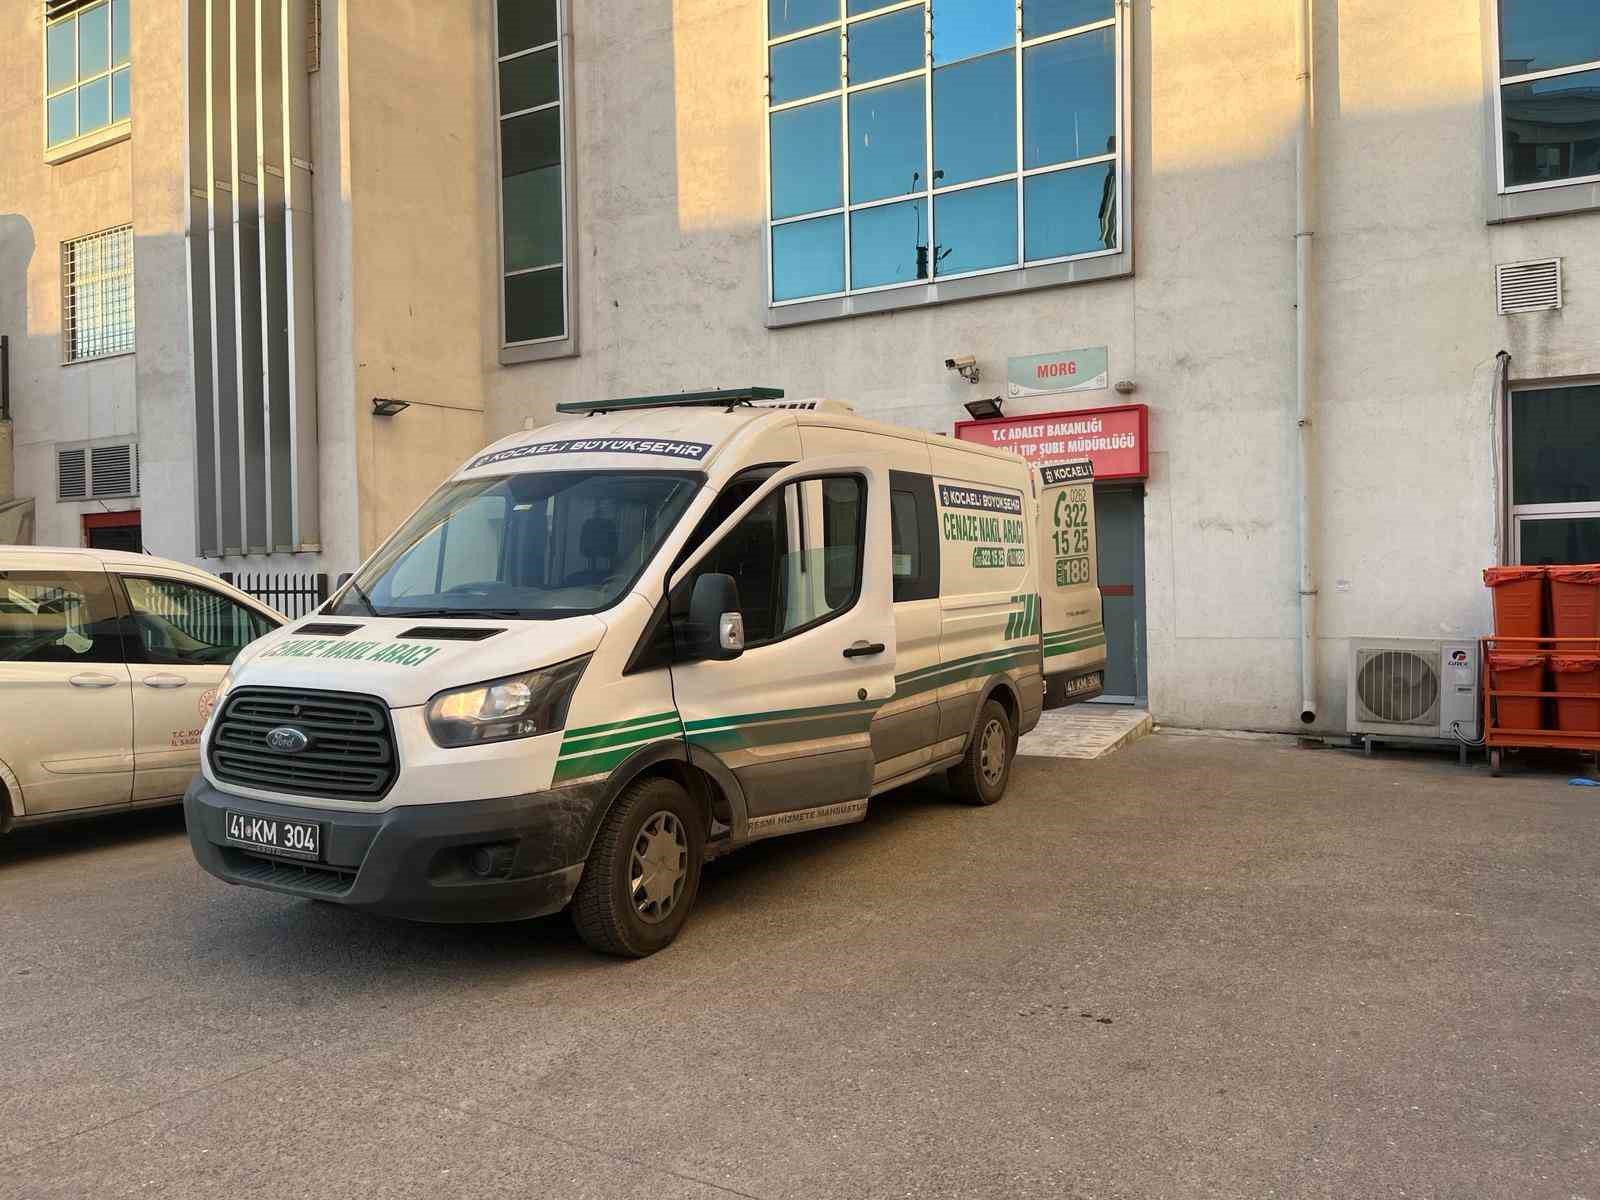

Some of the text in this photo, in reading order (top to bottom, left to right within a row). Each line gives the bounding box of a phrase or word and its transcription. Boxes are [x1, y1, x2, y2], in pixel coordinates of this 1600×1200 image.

[1037, 362, 1077, 379] MORG
[1008, 425, 1044, 440] ADALET
[1047, 417, 1102, 436] BAKANLIĞI
[570, 440, 703, 457] BÜYÜKŞEHİR
[1020, 444, 1037, 456] TIP
[1039, 441, 1065, 458] ŞUBE
[1067, 433, 1135, 453] MÜDÜRLÜĞÜ
[943, 512, 978, 541] CENAZE
[1003, 519, 1024, 544] ARACI
[1064, 503, 1088, 528] 322
[1053, 527, 1089, 555] 15 25
[1065, 558, 1089, 585] 188
[365, 643, 441, 667] ARACI
[271, 732, 294, 746] Ford
[231, 815, 315, 850] 41 KM 304
